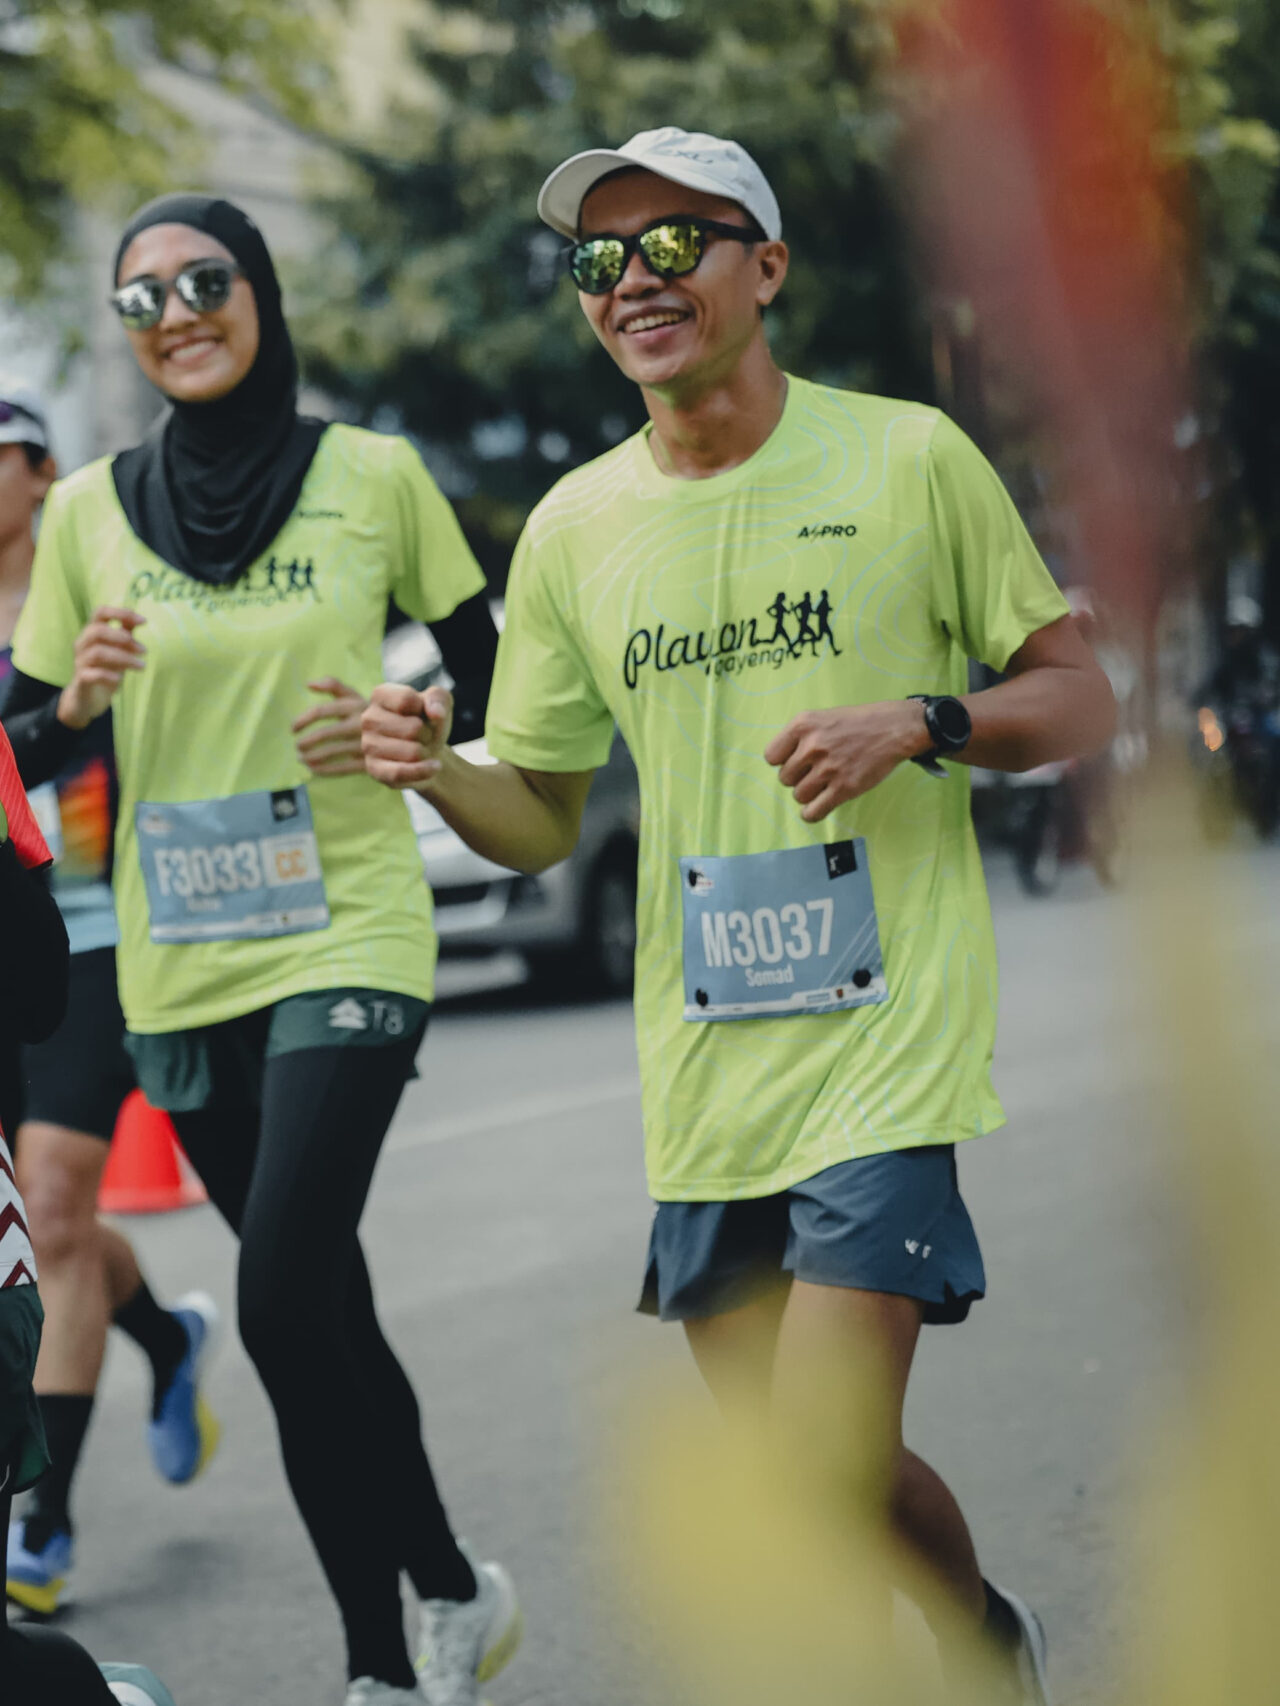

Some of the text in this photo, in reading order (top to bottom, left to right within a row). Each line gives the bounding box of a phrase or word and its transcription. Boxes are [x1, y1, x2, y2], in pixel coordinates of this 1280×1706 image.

[715, 647, 787, 681] gayeng
[154, 841, 261, 897] F3033
[275, 849, 308, 880] CC
[701, 897, 834, 968] M3037
[745, 963, 794, 988] Somad
[367, 1000, 405, 1035] T8
